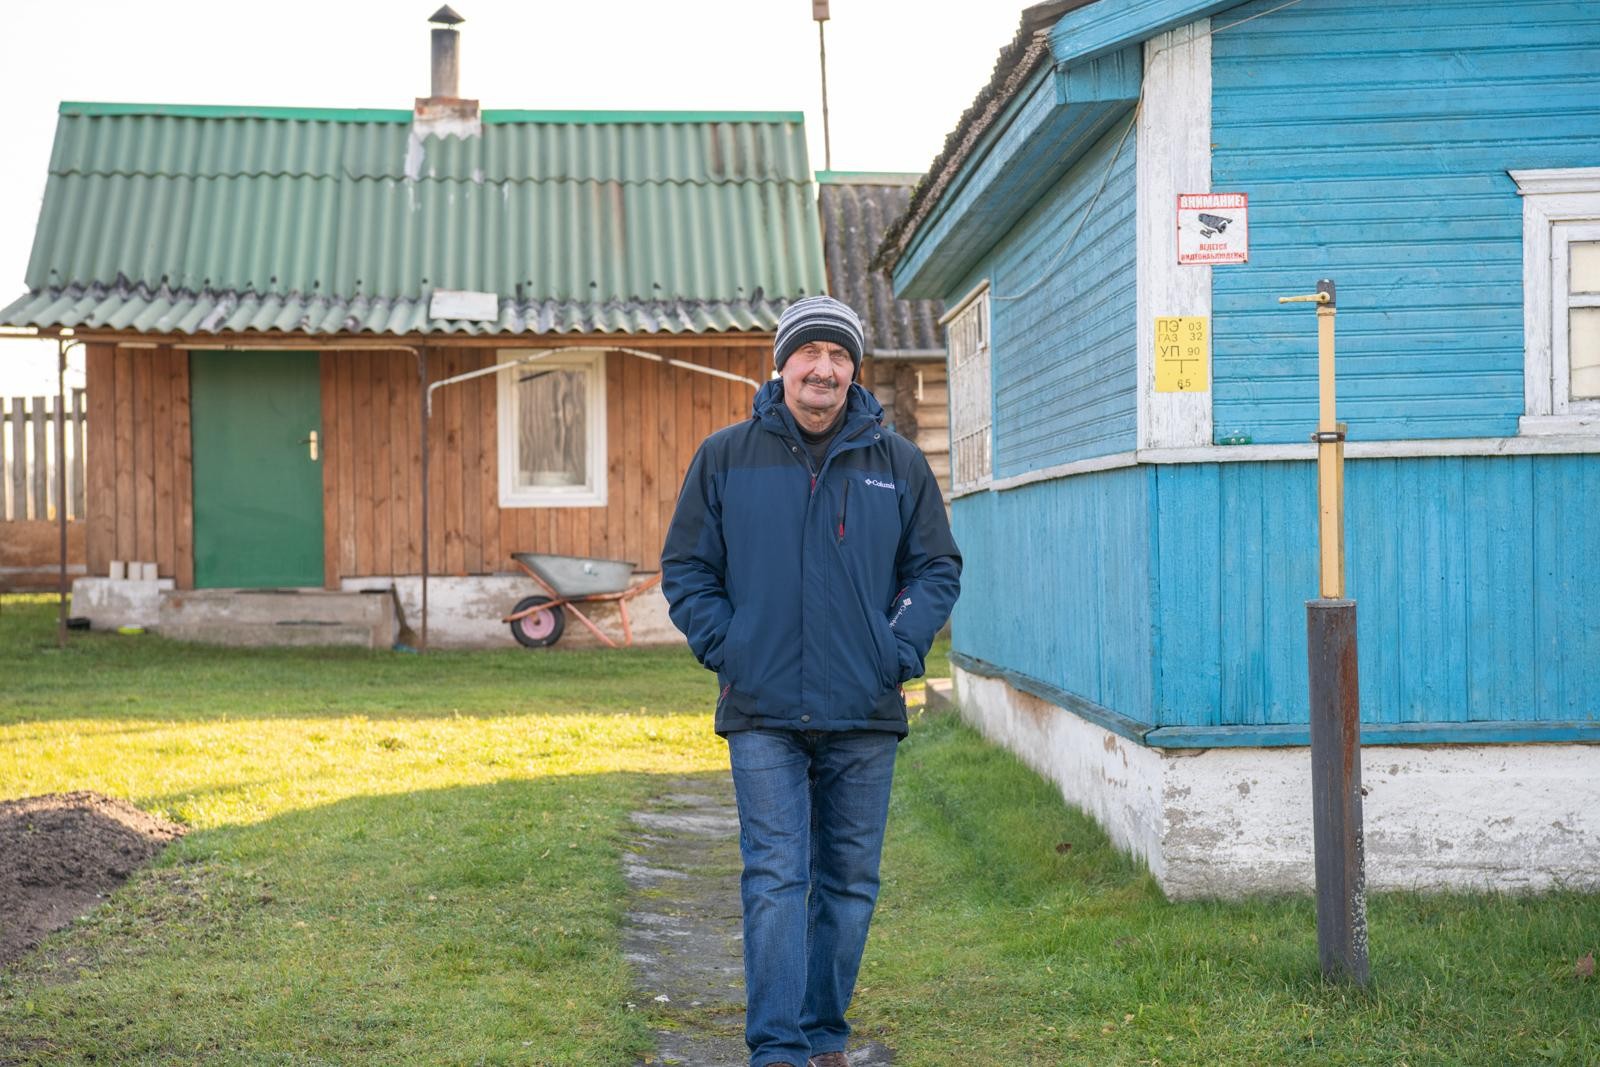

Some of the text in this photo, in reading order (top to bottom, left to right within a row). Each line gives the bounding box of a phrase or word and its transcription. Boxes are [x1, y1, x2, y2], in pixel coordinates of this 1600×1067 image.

[1158, 320, 1202, 333] ПЭ 03
[1158, 332, 1203, 342] ГАЗ 32
[1160, 345, 1200, 358] УП 90
